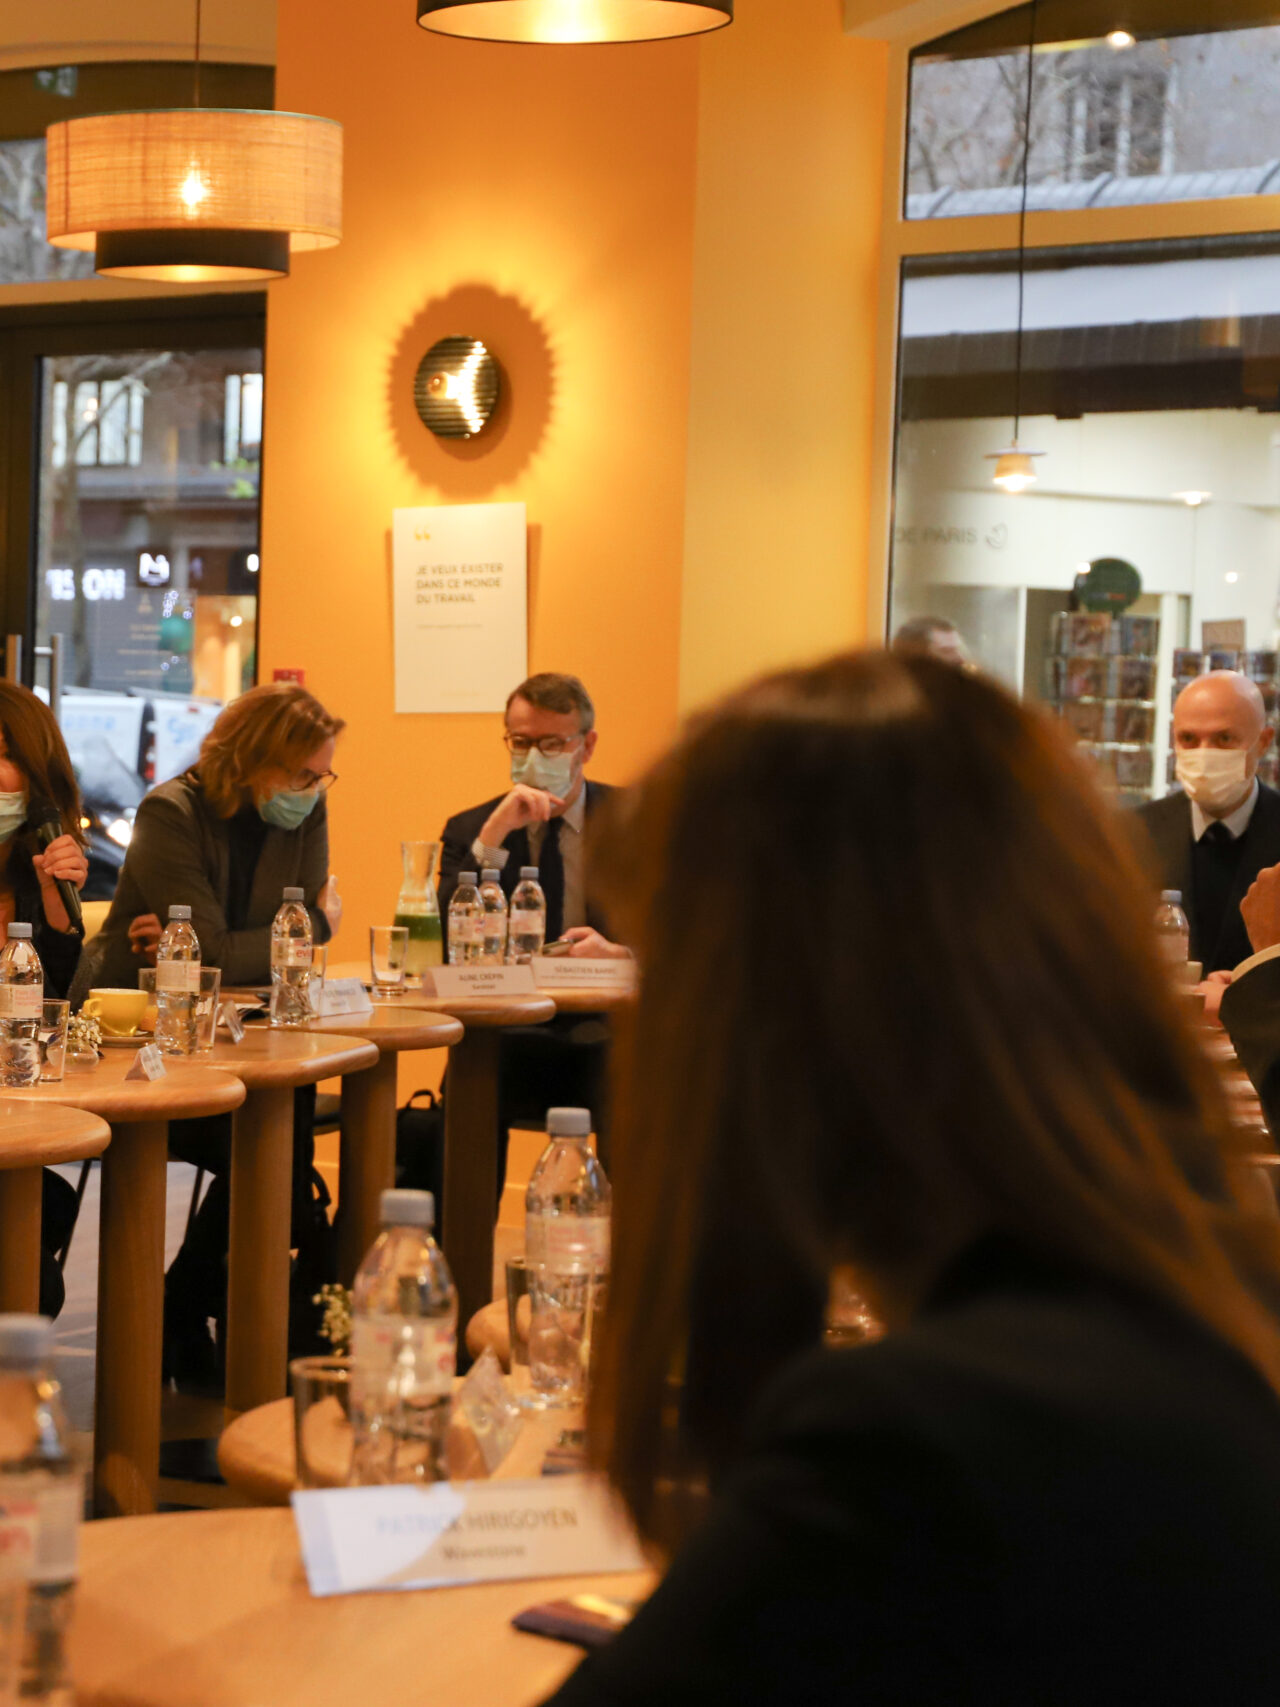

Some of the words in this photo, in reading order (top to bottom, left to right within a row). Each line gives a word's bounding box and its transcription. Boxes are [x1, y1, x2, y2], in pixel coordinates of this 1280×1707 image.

[923, 526, 978, 544] PARIS
[416, 564, 428, 575] JE
[431, 563, 458, 574] VEUX
[461, 562, 504, 574] EXISTER
[416, 579, 444, 589] DANS
[447, 578, 460, 589] CE
[463, 577, 502, 588] MONDE
[416, 593, 431, 604] DU
[433, 593, 476, 603] TRAVAIL
[376, 1512, 461, 1535] PATRICK
[468, 1507, 578, 1534] HIRIGOYEN
